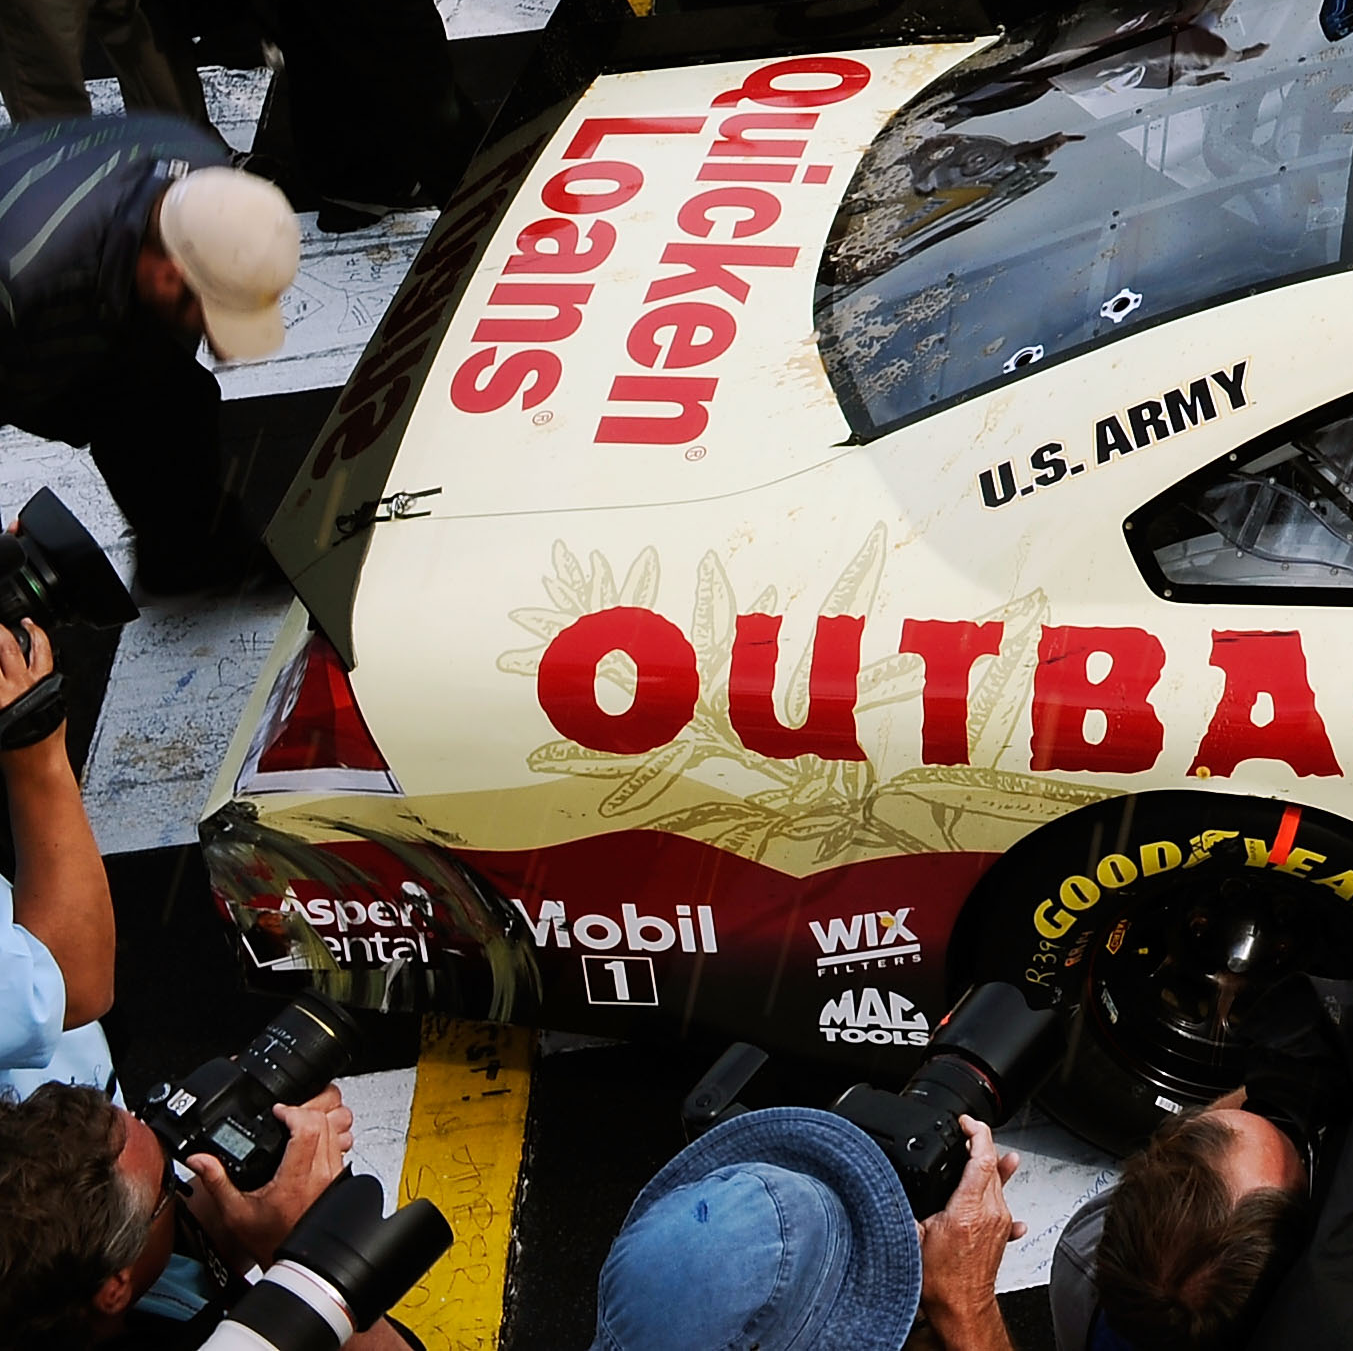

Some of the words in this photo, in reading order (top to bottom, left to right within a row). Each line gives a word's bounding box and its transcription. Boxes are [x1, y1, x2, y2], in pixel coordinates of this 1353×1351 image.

[449, 115, 710, 415] Loans
[592, 55, 873, 445] Quicken
[1094, 361, 1254, 465] ARMY
[324, 930, 430, 964] ental
[511, 897, 719, 954] Mobil
[809, 908, 920, 954] WIX
[816, 952, 923, 978] FILTERS
[818, 986, 928, 1030] MAC
[818, 1028, 930, 1047] TOOLS
